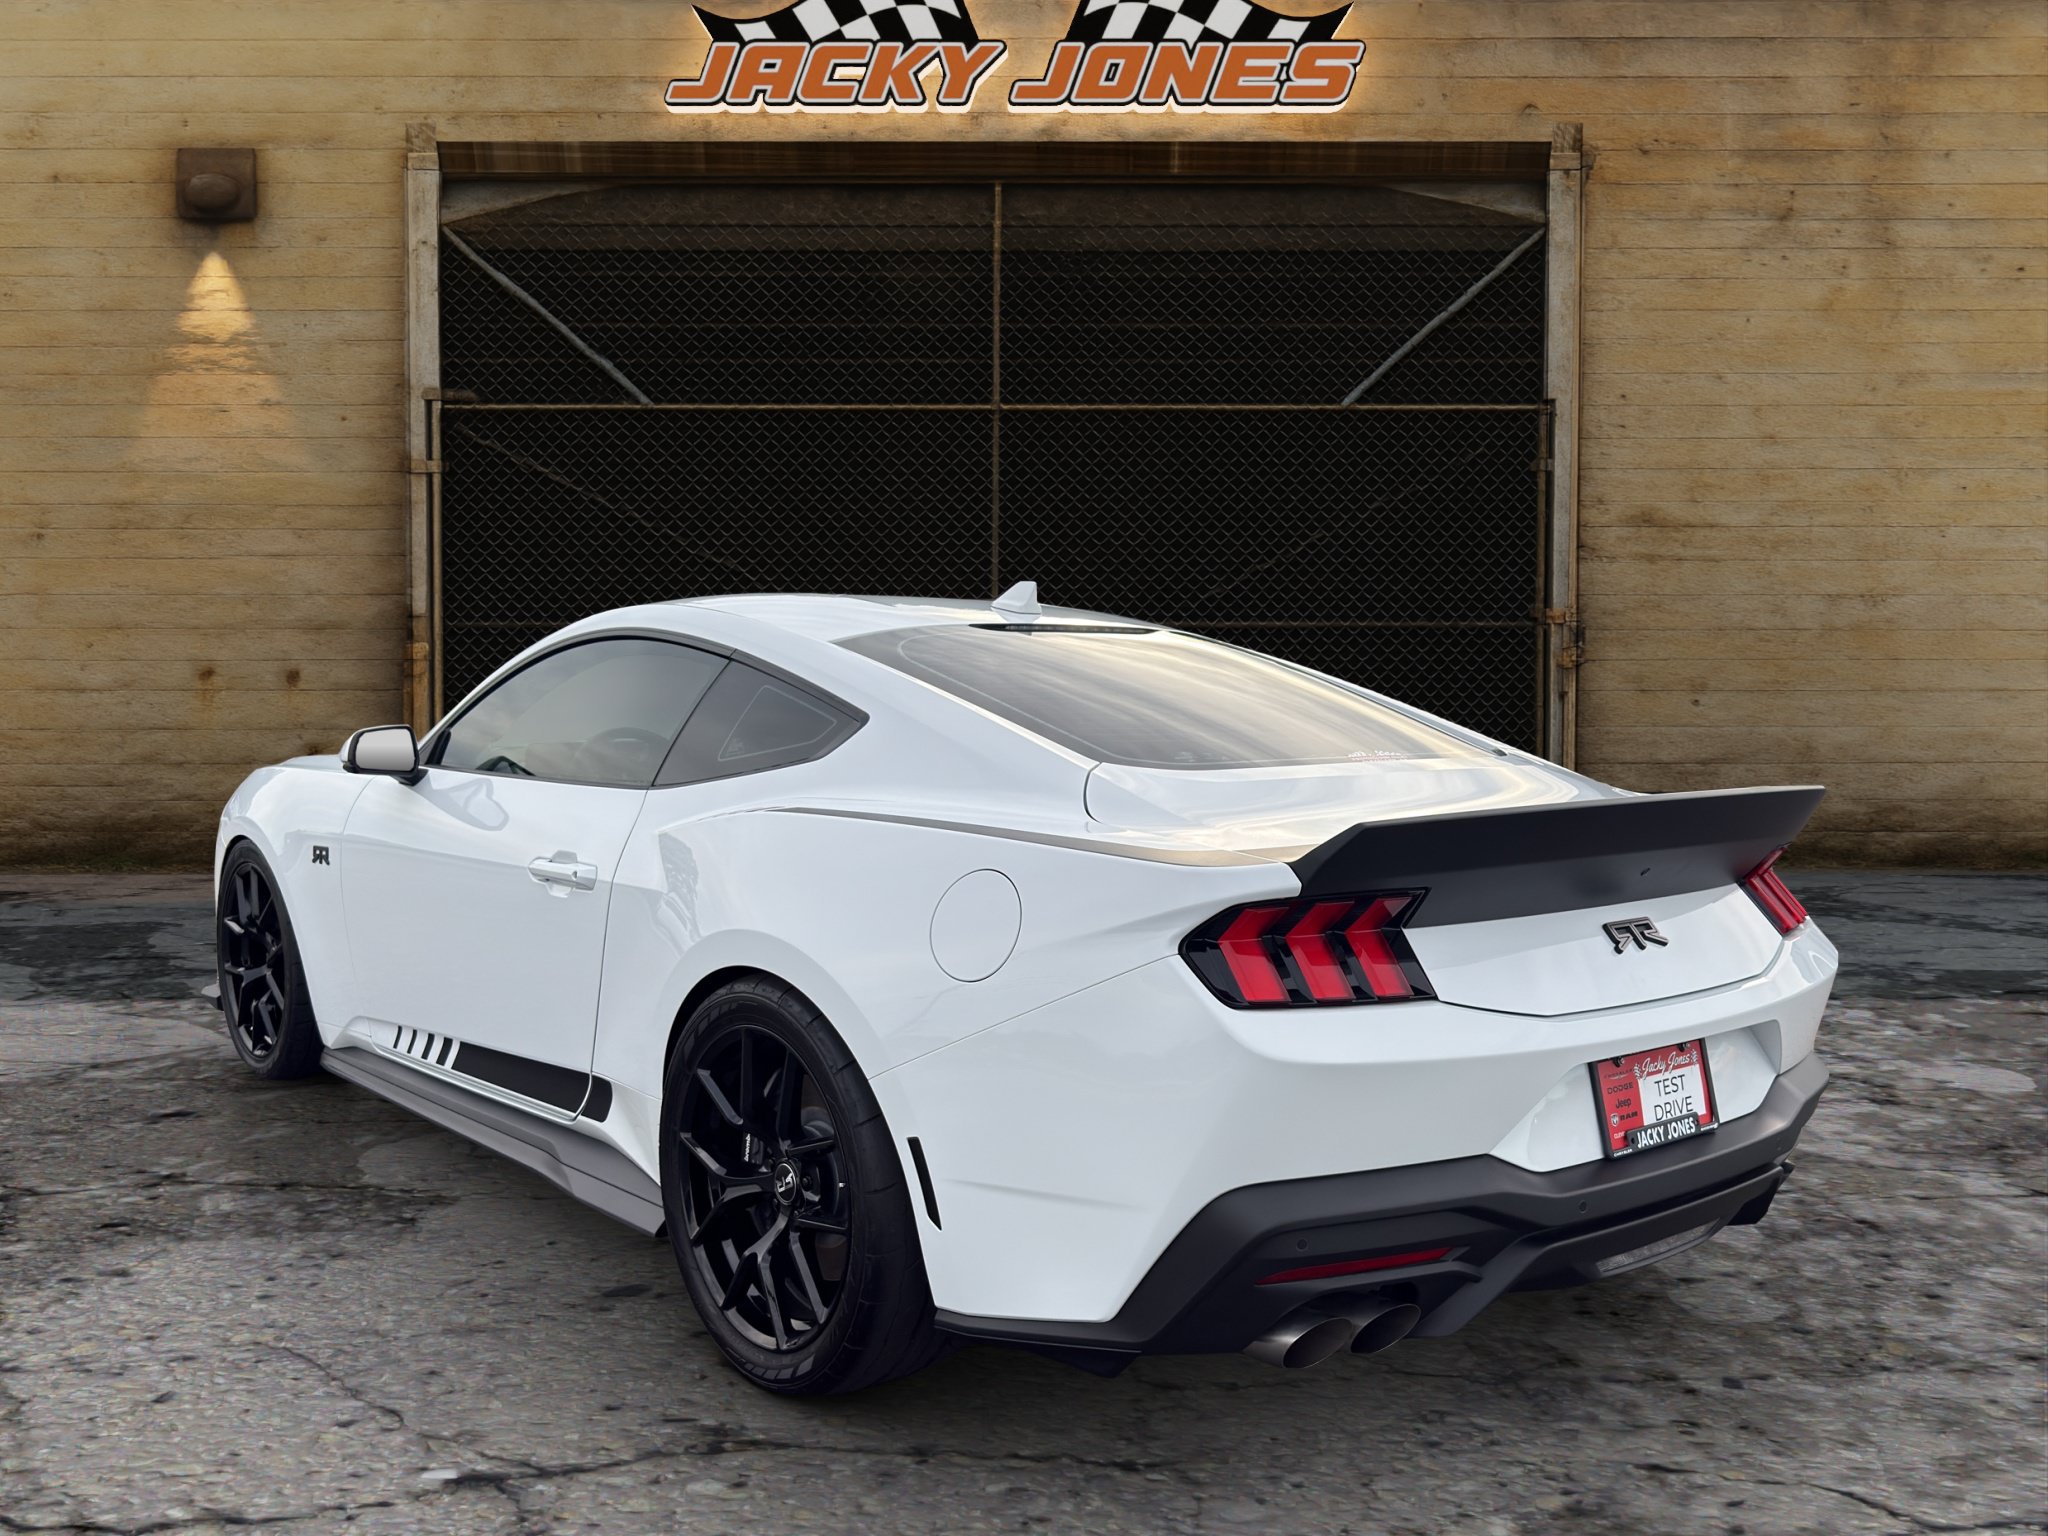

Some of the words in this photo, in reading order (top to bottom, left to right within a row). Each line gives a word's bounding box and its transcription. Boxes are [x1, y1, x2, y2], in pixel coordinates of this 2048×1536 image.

[665, 39, 1007, 108] JACKY
[1008, 39, 1366, 108] JONES
[1641, 1056, 1667, 1081] Jacky
[1668, 1051, 1690, 1075] Jones
[1607, 1082, 1634, 1095] DODGE
[1654, 1074, 1686, 1097] TEST
[1615, 1098, 1632, 1109] Jeep
[1653, 1096, 1694, 1122] DRIVE
[1620, 1111, 1638, 1121] RAM
[1637, 1125, 1666, 1149] JACKY
[1667, 1117, 1697, 1139] JONES
